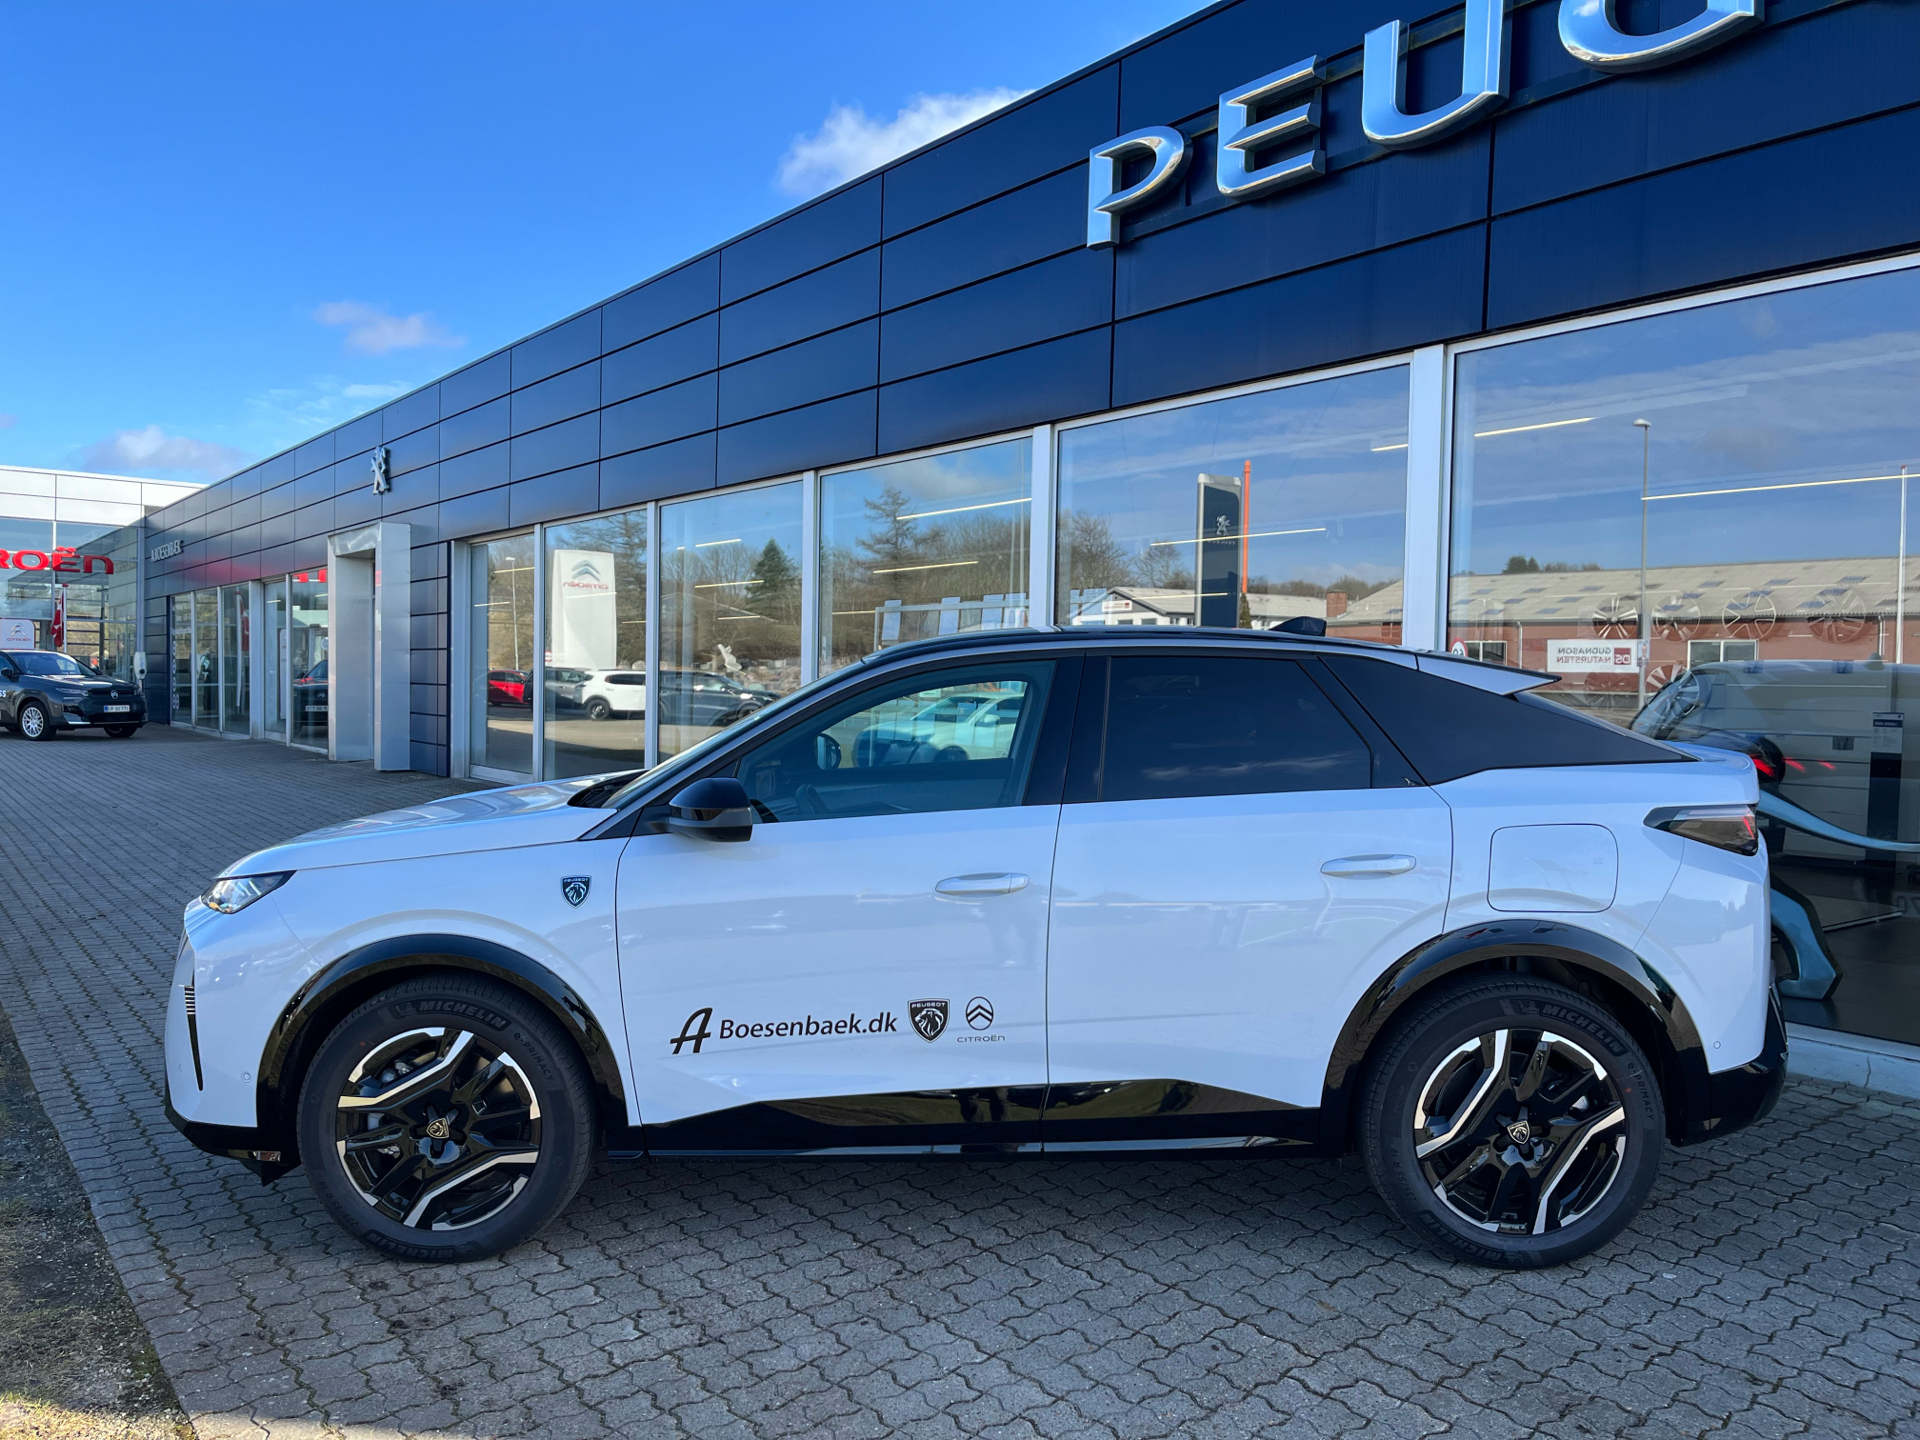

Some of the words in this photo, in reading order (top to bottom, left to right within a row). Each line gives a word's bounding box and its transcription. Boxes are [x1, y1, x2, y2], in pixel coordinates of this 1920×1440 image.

[419, 1001, 507, 1029] MICHELIN
[719, 1012, 898, 1039] Boesenbaek.dk
[1542, 1004, 1624, 1054] MICHELIN
[1390, 1148, 1400, 1157] 19
[319, 1181, 329, 1189] 19
[1396, 1171, 1418, 1202] 235/55
[331, 1200, 359, 1227] 235/55
[366, 1232, 453, 1260] MICHELIN
[1419, 1212, 1503, 1262] MICHELIN
